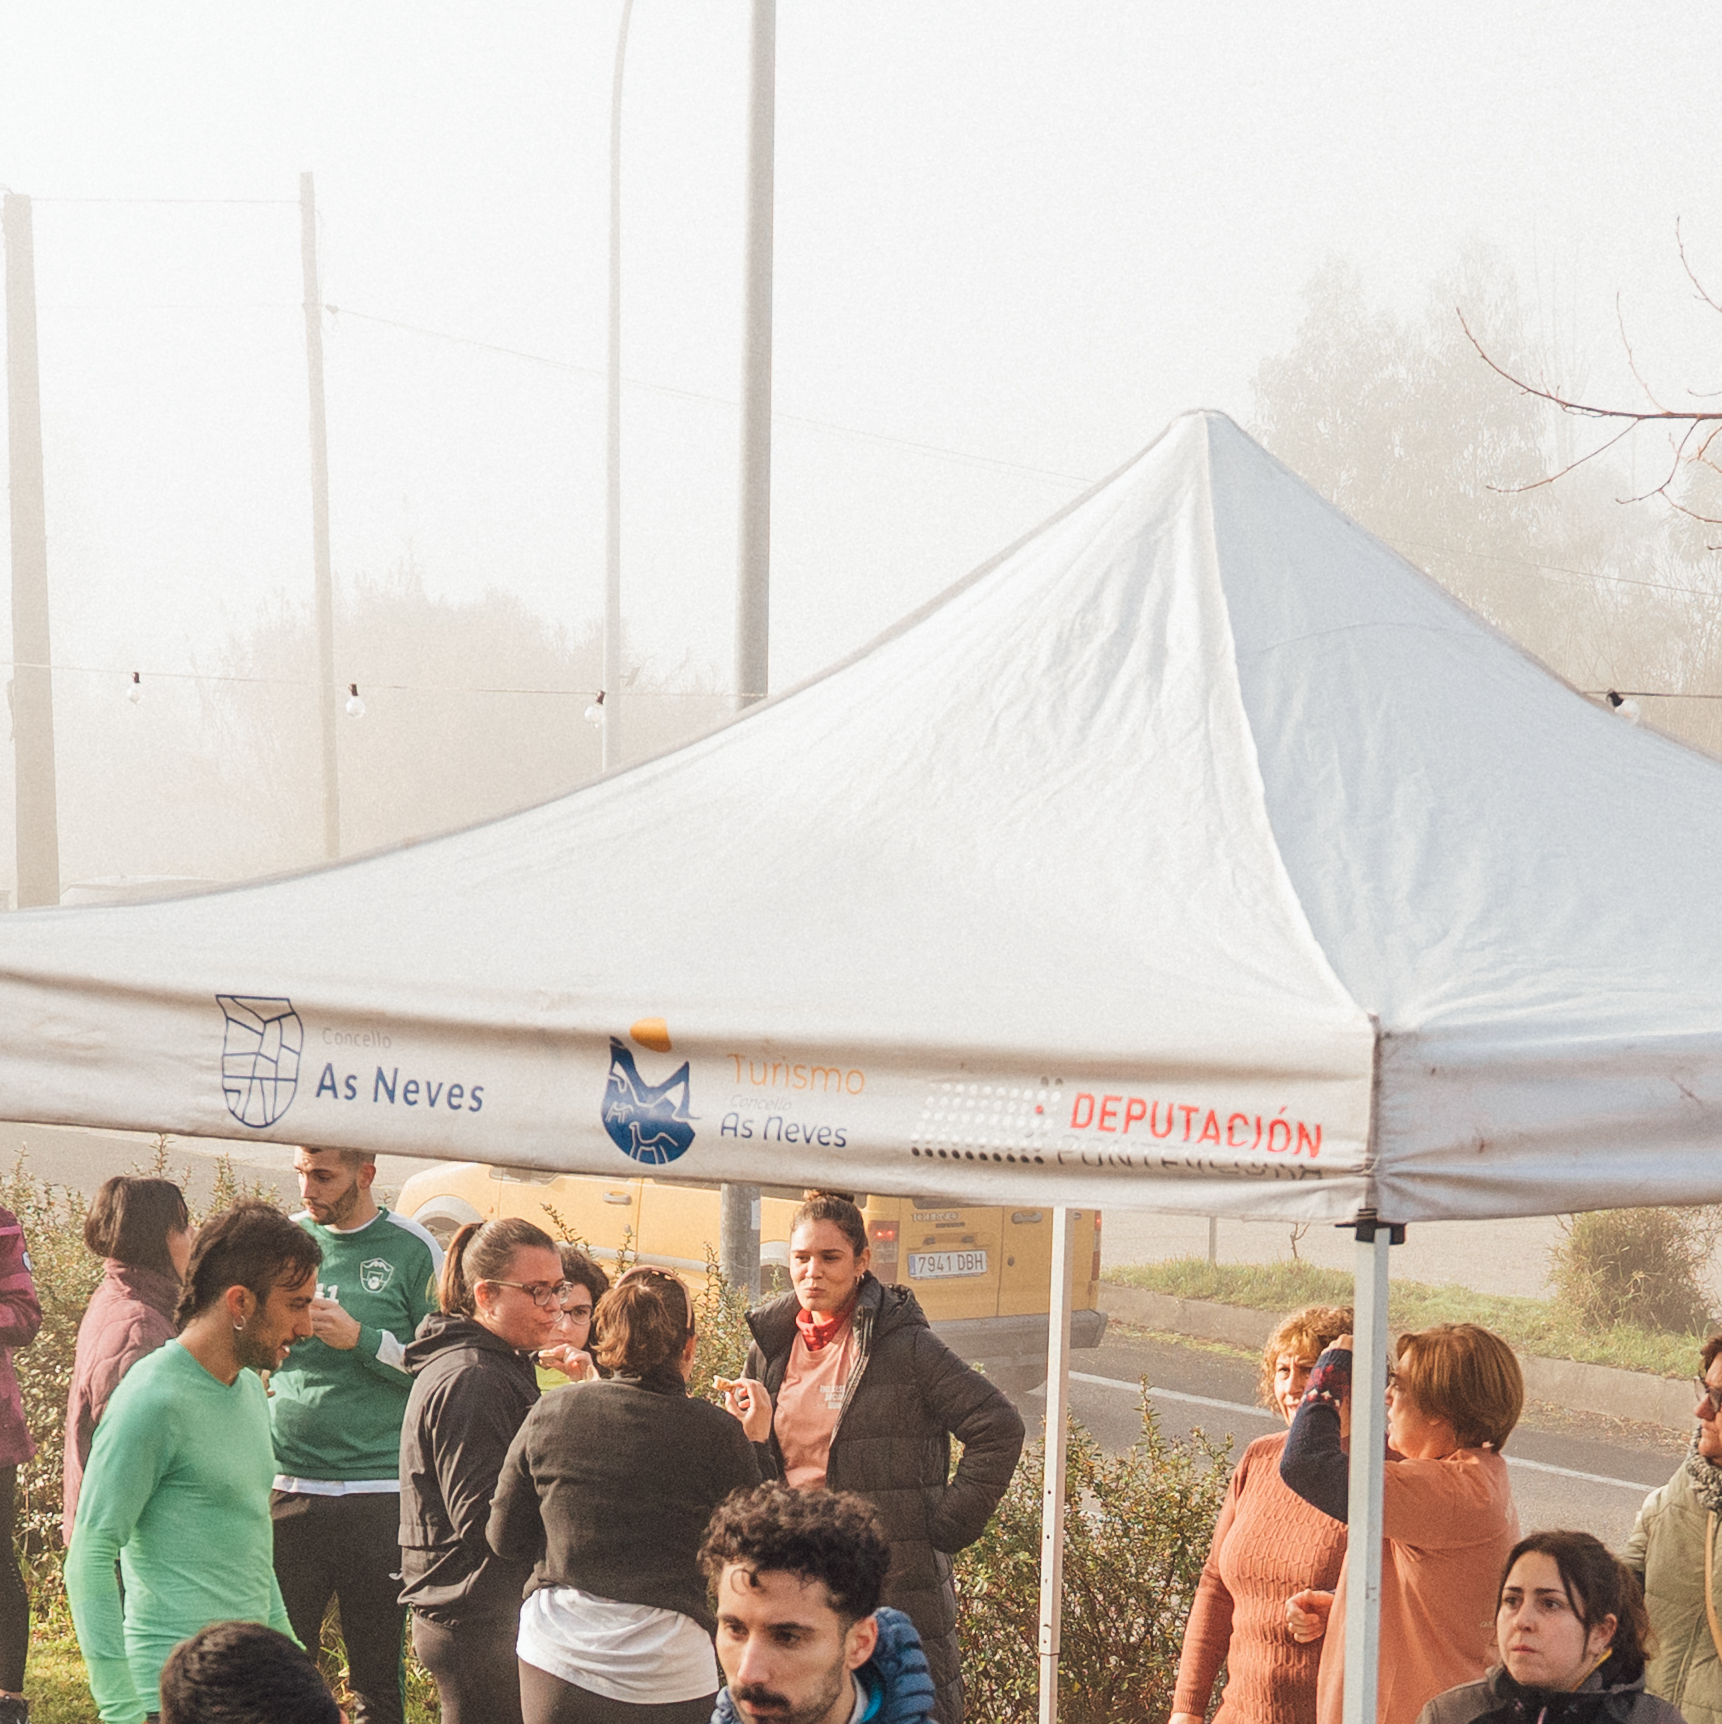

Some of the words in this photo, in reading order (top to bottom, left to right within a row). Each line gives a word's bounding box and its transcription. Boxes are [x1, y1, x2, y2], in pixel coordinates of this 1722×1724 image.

[322, 1028, 392, 1049] Concello
[316, 1063, 358, 1100] As
[373, 1066, 485, 1112] Neves
[727, 1053, 865, 1095] Turismo
[720, 1112, 754, 1139] As
[763, 1116, 848, 1147] Neves
[1070, 1092, 1323, 1158] DEPUTACIÓN
[918, 1255, 952, 1274] 7941
[957, 1253, 983, 1271] DBH
